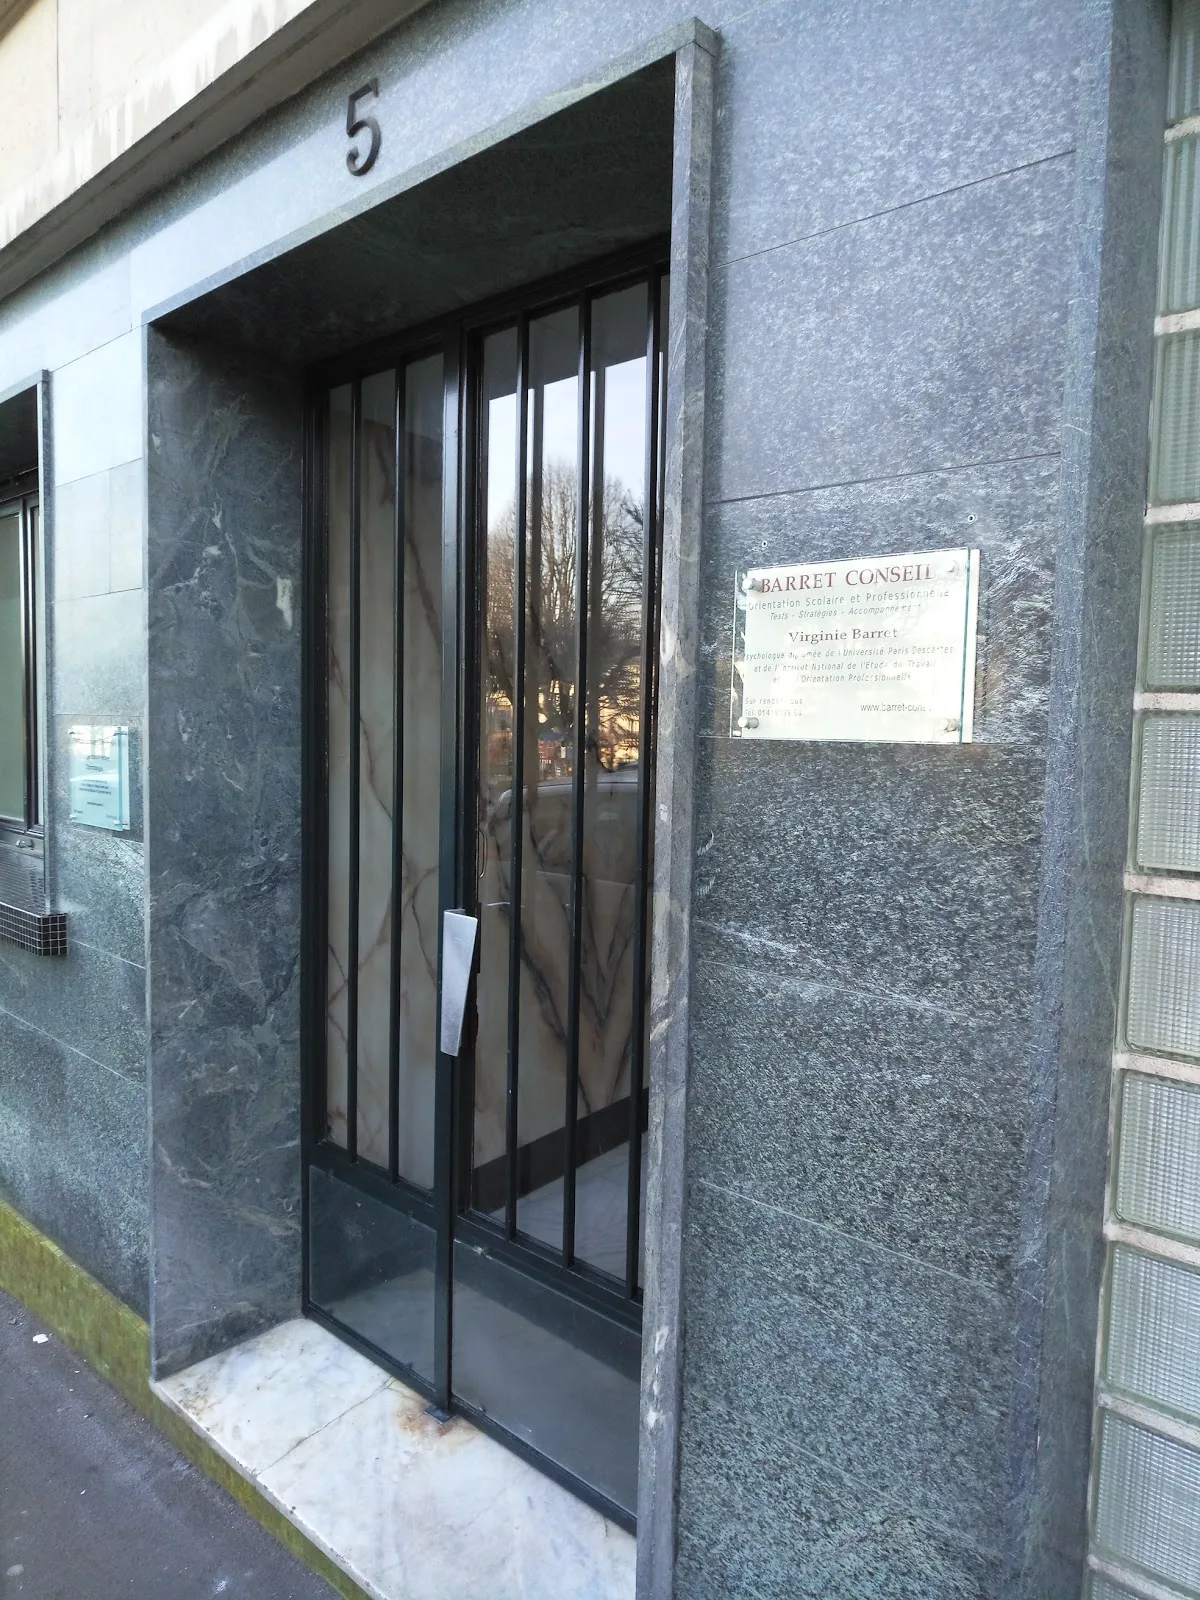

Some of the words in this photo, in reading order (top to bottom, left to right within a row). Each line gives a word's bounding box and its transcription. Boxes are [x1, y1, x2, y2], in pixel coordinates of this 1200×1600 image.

[346, 78, 382, 176] 5
[760, 572, 837, 594] BARRET
[845, 564, 936, 586] CONSEIL
[805, 595, 845, 607] Scolaire
[850, 593, 861, 604] et
[770, 612, 789, 621] Tests
[798, 609, 838, 620] Stratégies
[788, 629, 847, 645] Virginie
[851, 627, 899, 640] Barret
[745, 651, 785, 662] sychologue
[825, 649, 835, 658] de
[838, 646, 884, 657] lUniversité
[887, 646, 909, 656] Paris
[754, 664, 762, 673] et
[763, 664, 772, 672] de
[811, 662, 844, 672] National
[847, 661, 857, 670] de
